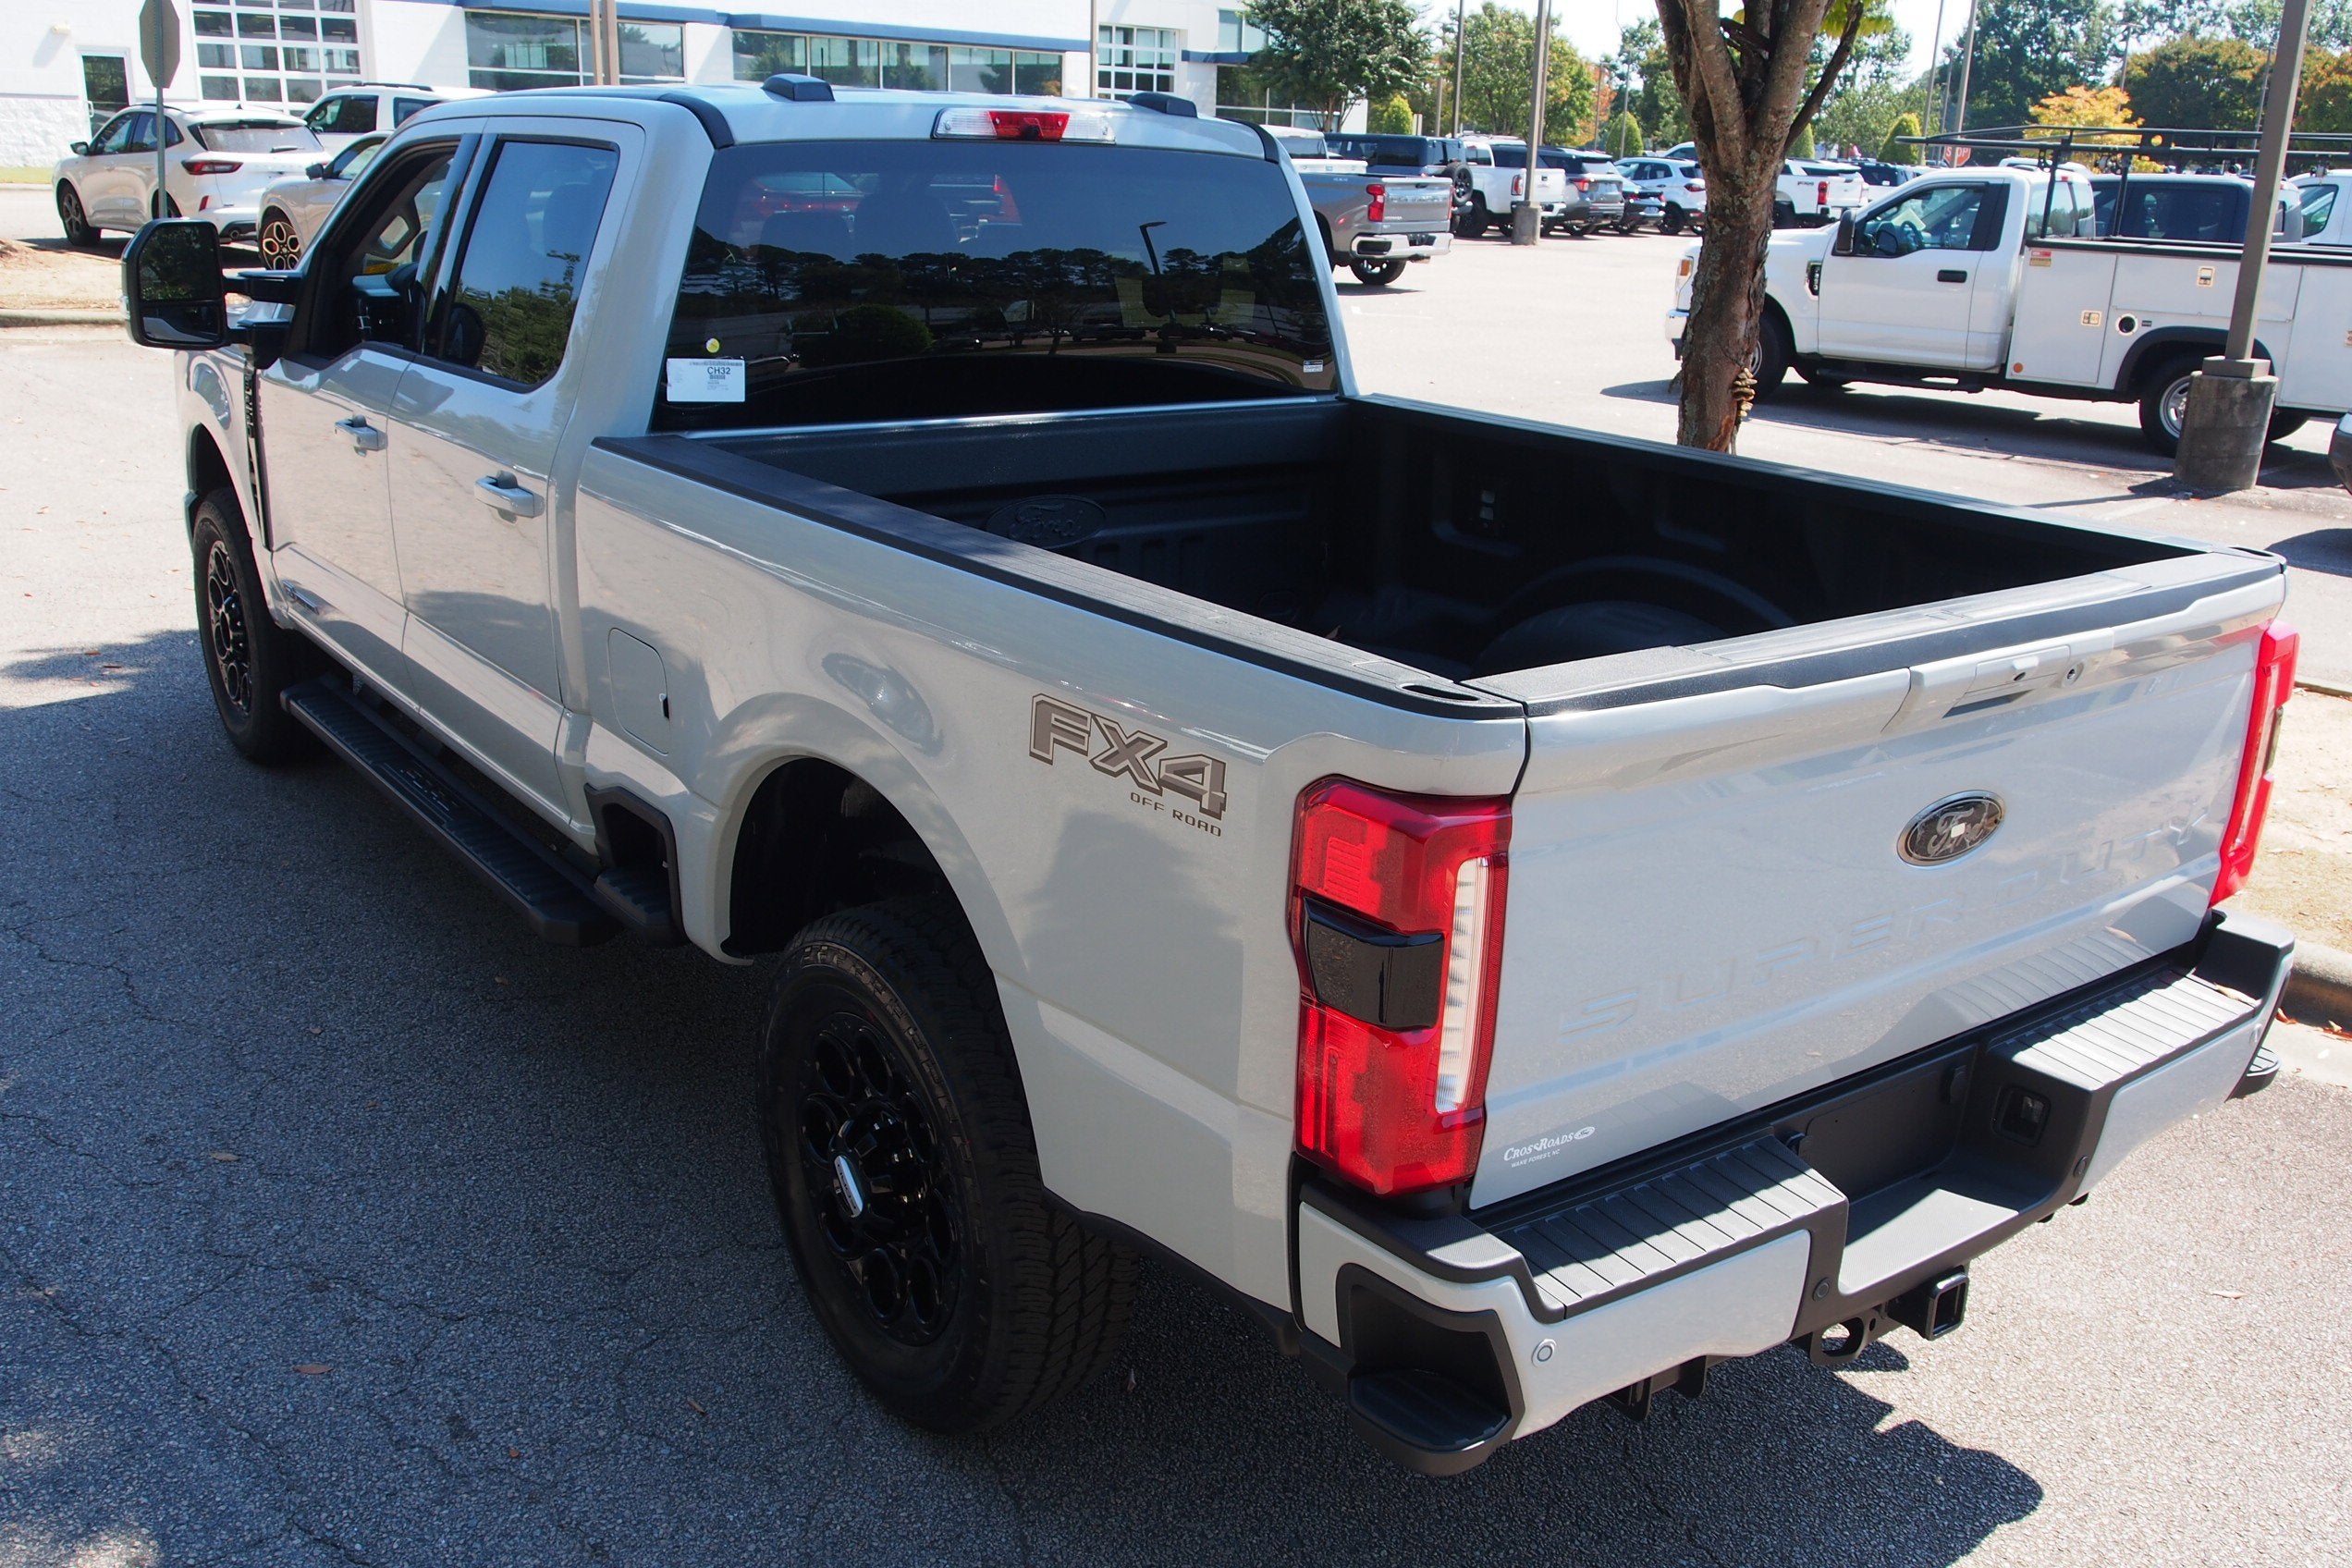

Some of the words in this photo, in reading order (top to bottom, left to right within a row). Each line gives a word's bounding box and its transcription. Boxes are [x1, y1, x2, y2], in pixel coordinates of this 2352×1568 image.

[1946, 146, 1969, 157] SOP
[706, 366, 731, 375] CH32
[1029, 693, 1228, 821] FX4
[1130, 791, 1165, 811] OFF
[1171, 809, 1222, 838] ROAD
[1557, 891, 1969, 1040] SUPER
[1511, 1158, 1527, 1168] WAKE
